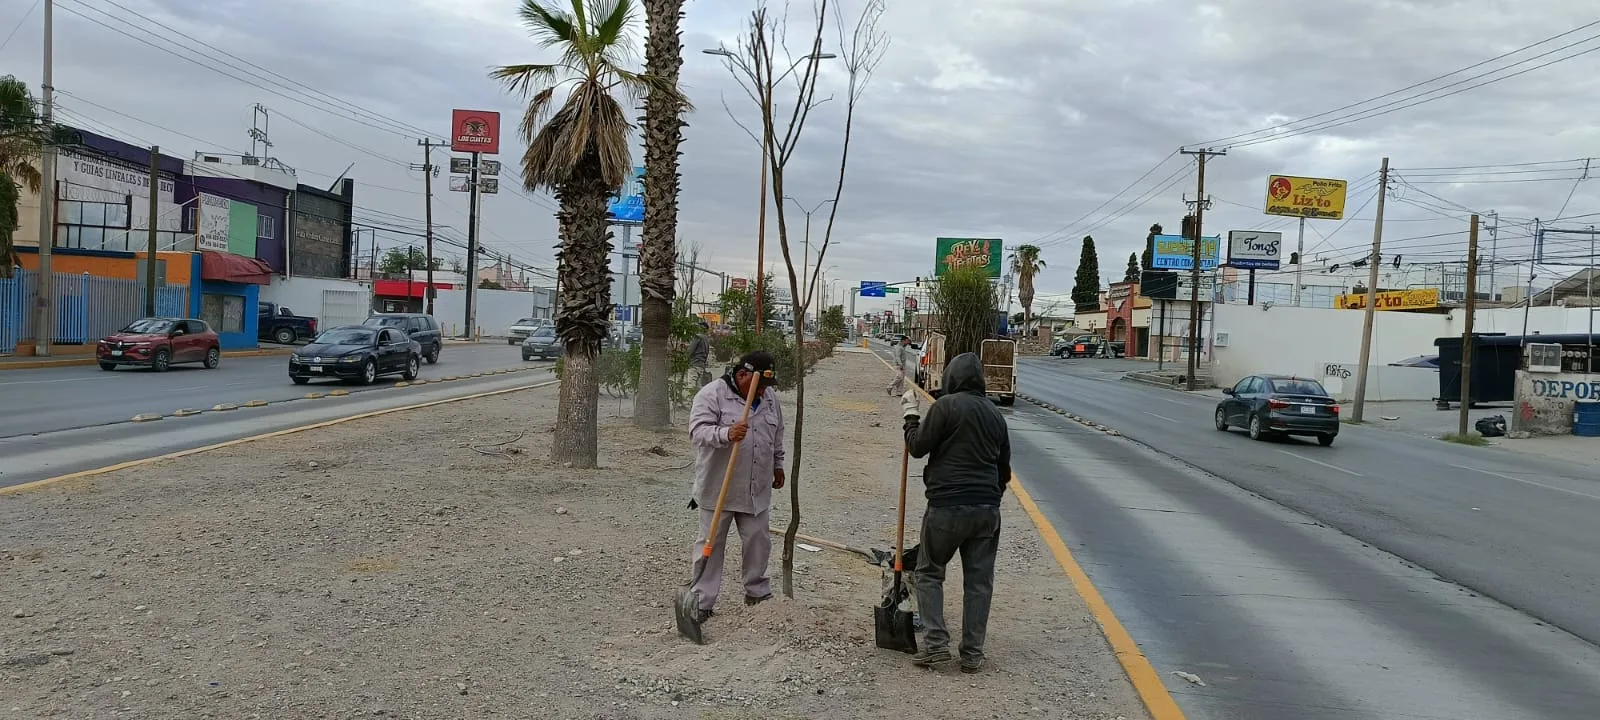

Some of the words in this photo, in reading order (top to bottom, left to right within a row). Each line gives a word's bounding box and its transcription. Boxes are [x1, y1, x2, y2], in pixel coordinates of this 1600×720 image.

[74, 161, 79, 171] Y
[81, 163, 103, 178] GUIAS
[105, 166, 136, 185] LINEALES
[1157, 257, 1179, 266] CENTRO
[1359, 294, 1402, 309] Lz'to
